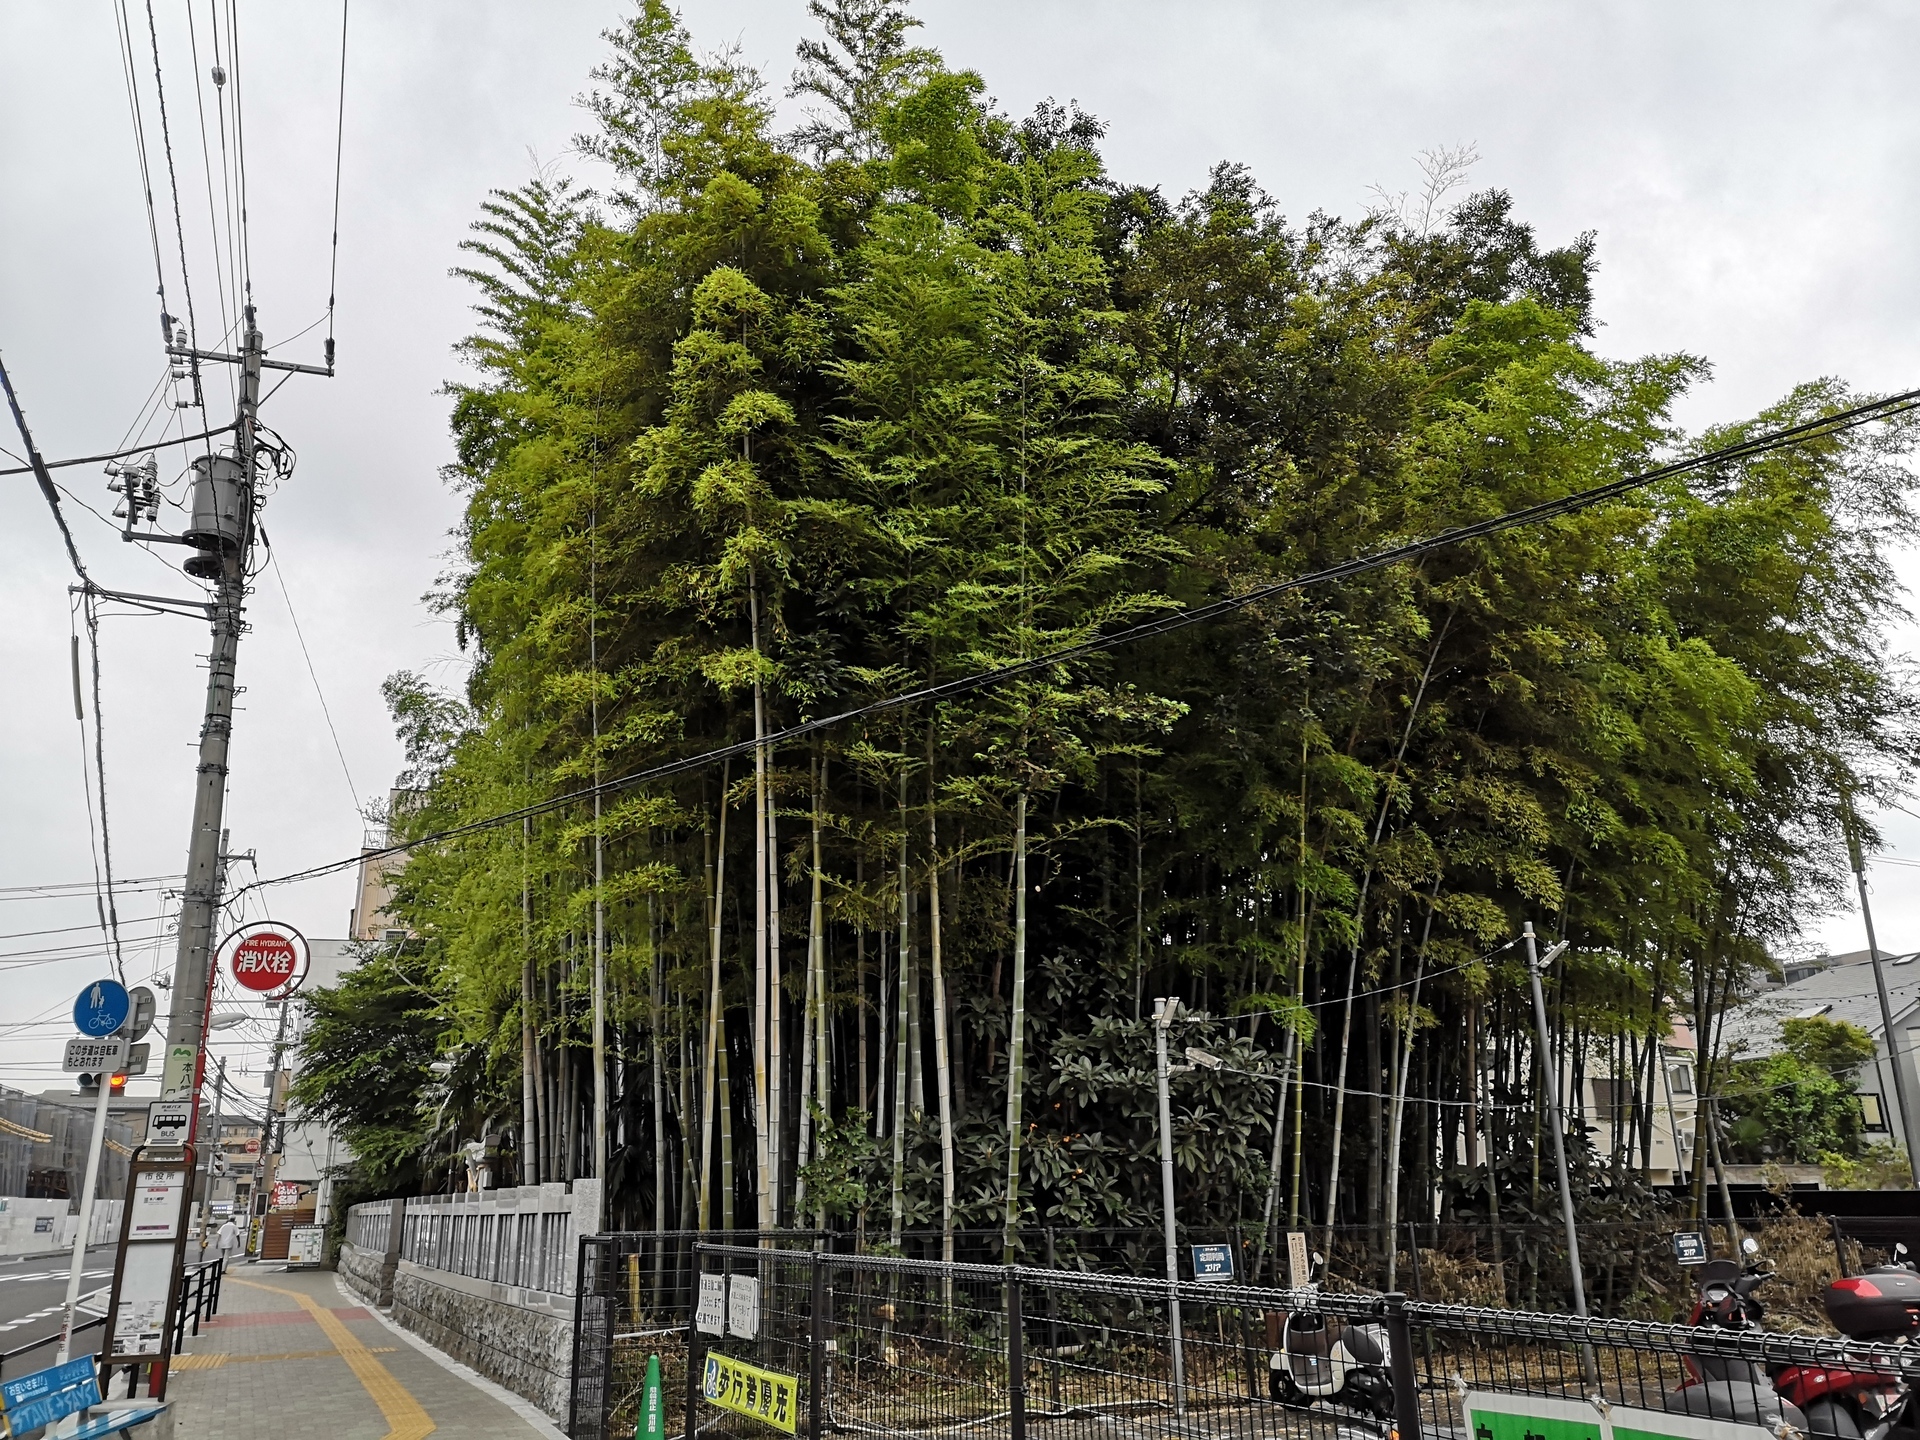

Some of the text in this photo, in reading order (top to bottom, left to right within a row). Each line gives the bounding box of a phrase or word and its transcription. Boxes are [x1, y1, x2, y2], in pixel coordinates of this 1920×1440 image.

[236, 949, 292, 973] 消火栓
[69, 1045, 118, 1056] この歩道は自転車
[67, 1057, 104, 1067] もとおれます
[145, 1171, 175, 1180] 市役所
[1204, 1263, 1221, 1272] エリア
[718, 1365, 788, 1423] 歩行者優先
